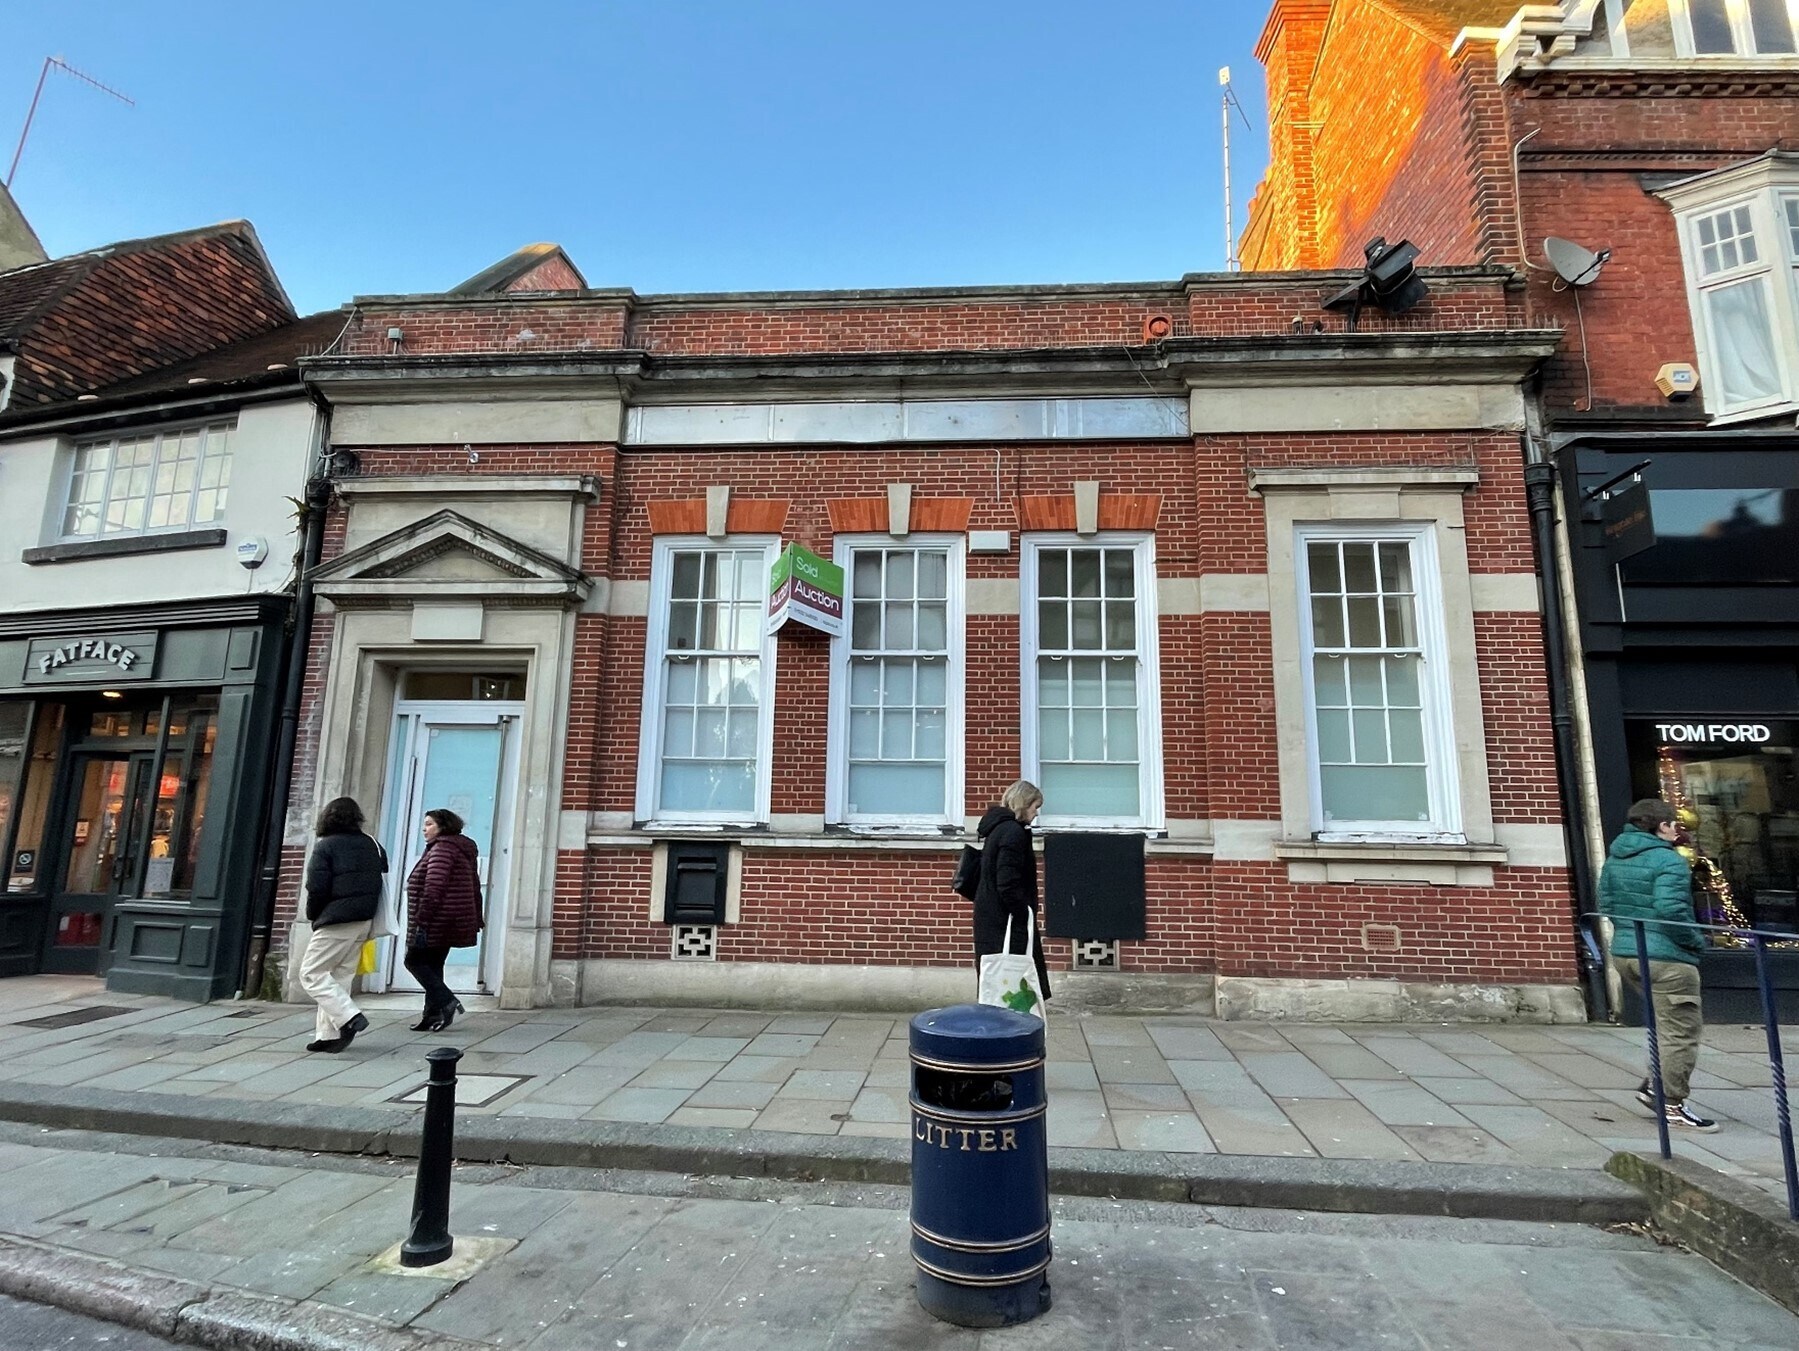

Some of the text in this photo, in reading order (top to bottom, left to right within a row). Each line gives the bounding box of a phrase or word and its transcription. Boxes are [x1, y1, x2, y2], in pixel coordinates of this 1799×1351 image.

[796, 556, 818, 578] Sold
[795, 579, 840, 611] Auction
[40, 640, 135, 674] FATFACE
[1655, 724, 1771, 742] TOM FORD
[915, 1116, 1018, 1152] LITTER
